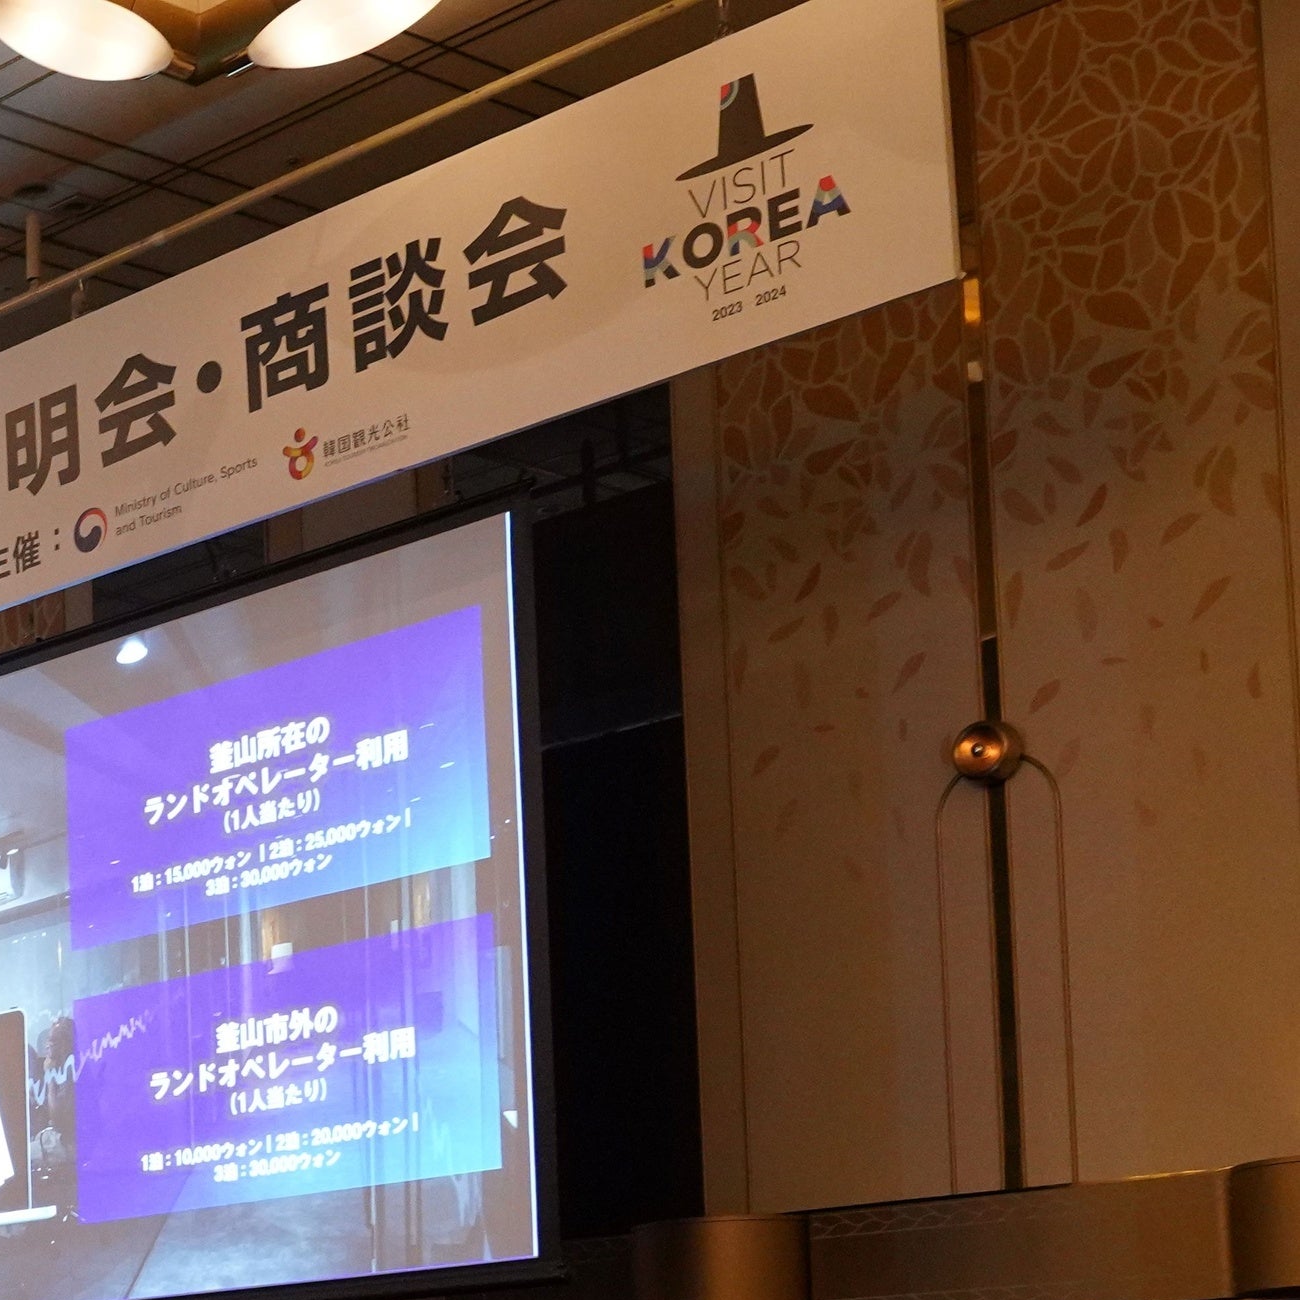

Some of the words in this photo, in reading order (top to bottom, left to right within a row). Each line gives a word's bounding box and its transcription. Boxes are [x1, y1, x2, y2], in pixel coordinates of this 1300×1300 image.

[687, 148, 795, 219] VISIT
[642, 175, 852, 289] KOREA
[694, 240, 803, 302] YEAR
[711, 302, 744, 322] 2023
[755, 285, 788, 307] 2024
[114, 493, 158, 519] Ministry
[160, 486, 171, 503] of
[174, 470, 219, 496] Culture,
[220, 456, 258, 482] Sports
[115, 519, 136, 536] and
[139, 503, 182, 528] Tourism
[208, 715, 331, 775] 釜山所在の
[215, 1005, 339, 1054] 釜山市外の
